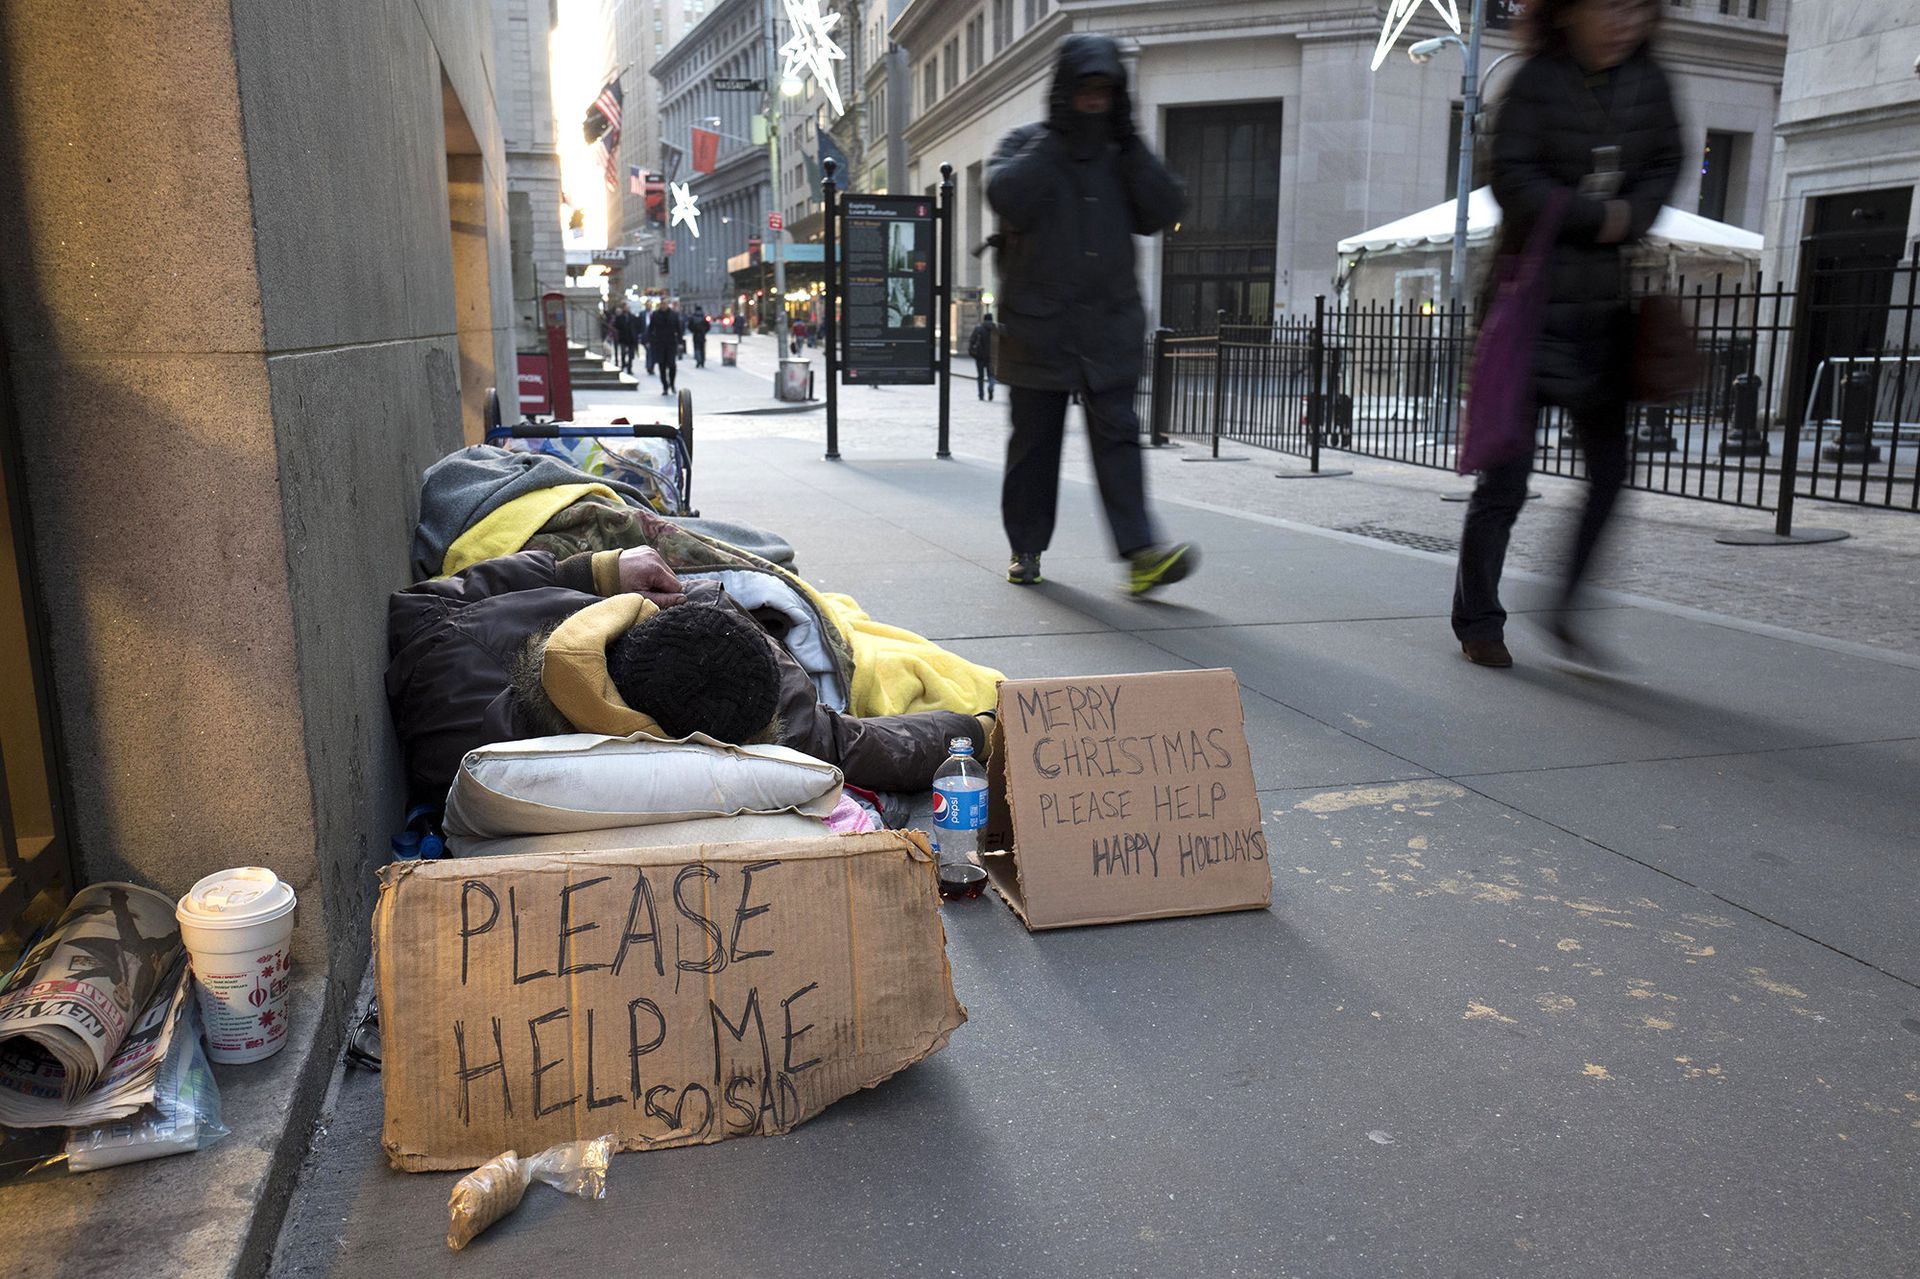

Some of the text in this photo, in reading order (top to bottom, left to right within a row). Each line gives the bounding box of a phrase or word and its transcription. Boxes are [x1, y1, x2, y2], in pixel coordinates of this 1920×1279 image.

[1016, 684, 1122, 734] MERRY
[1032, 728, 1233, 779] CHRISTMAS
[950, 797, 960, 824] pepsi
[1039, 782, 1227, 828] PLEASE HELP
[1092, 828, 1267, 878] HAPPY HOLIDAYS
[458, 860, 781, 990] PLEASE
[39, 1000, 104, 1037] NEW
[454, 981, 823, 1127] HELP ME
[639, 1072, 801, 1141] SO SAD
